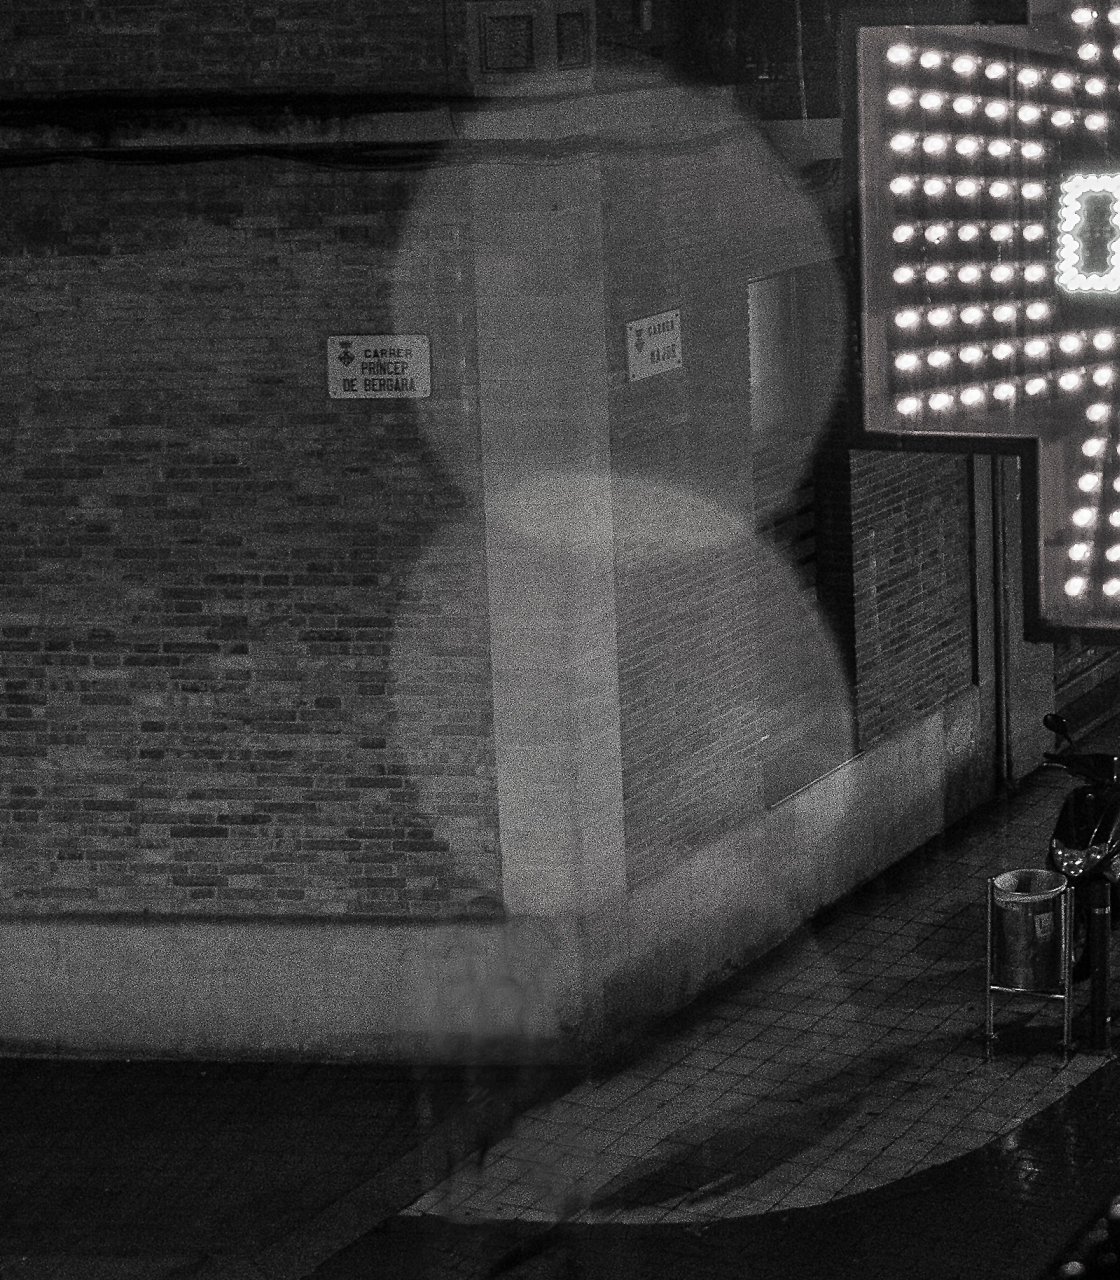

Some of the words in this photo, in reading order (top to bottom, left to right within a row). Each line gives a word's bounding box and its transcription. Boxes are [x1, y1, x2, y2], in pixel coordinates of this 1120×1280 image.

[363, 348, 413, 359] CARRER
[342, 378, 358, 392] DE
[363, 378, 417, 392] BERGARA
